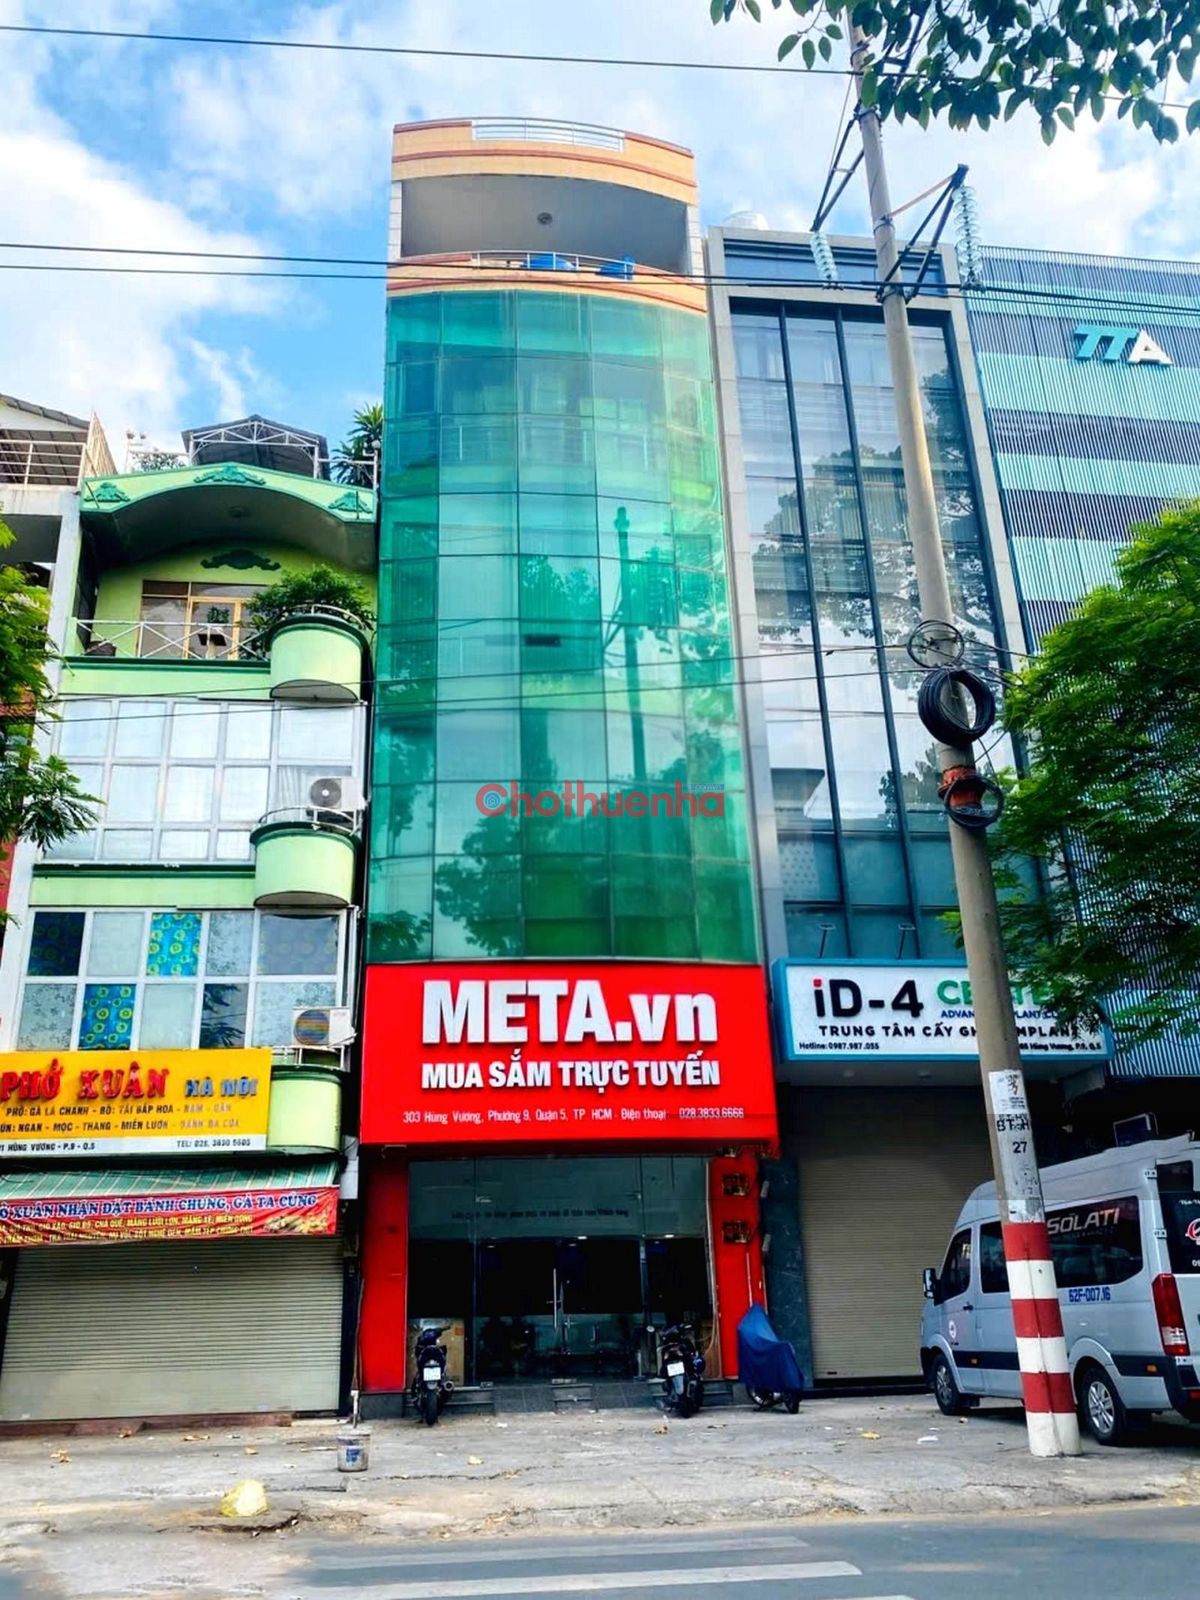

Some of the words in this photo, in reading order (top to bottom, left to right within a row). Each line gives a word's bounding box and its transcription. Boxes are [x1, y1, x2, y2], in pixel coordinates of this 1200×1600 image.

[1074, 324, 1173, 364] TTA
[422, 979, 718, 1043] META.vn
[813, 979, 924, 1018] iD-4
[818, 1025, 876, 1037] TRUNG
[882, 1022, 916, 1037] TÂM
[922, 1022, 953, 1037] CẤY
[77, 1061, 170, 1101] XUÂN
[421, 1062, 484, 1089] MUA
[489, 1049, 551, 1088] SẮM
[558, 1060, 629, 1093] TRỰC
[633, 1050, 720, 1087] TUYẾN
[403, 1110, 421, 1124] 303
[592, 1107, 613, 1120] HCM
[679, 1106, 744, 1119] 028.3833.6666
[1012, 1141, 1028, 1154] 27
[57, 1200, 99, 1218] NHẬN
